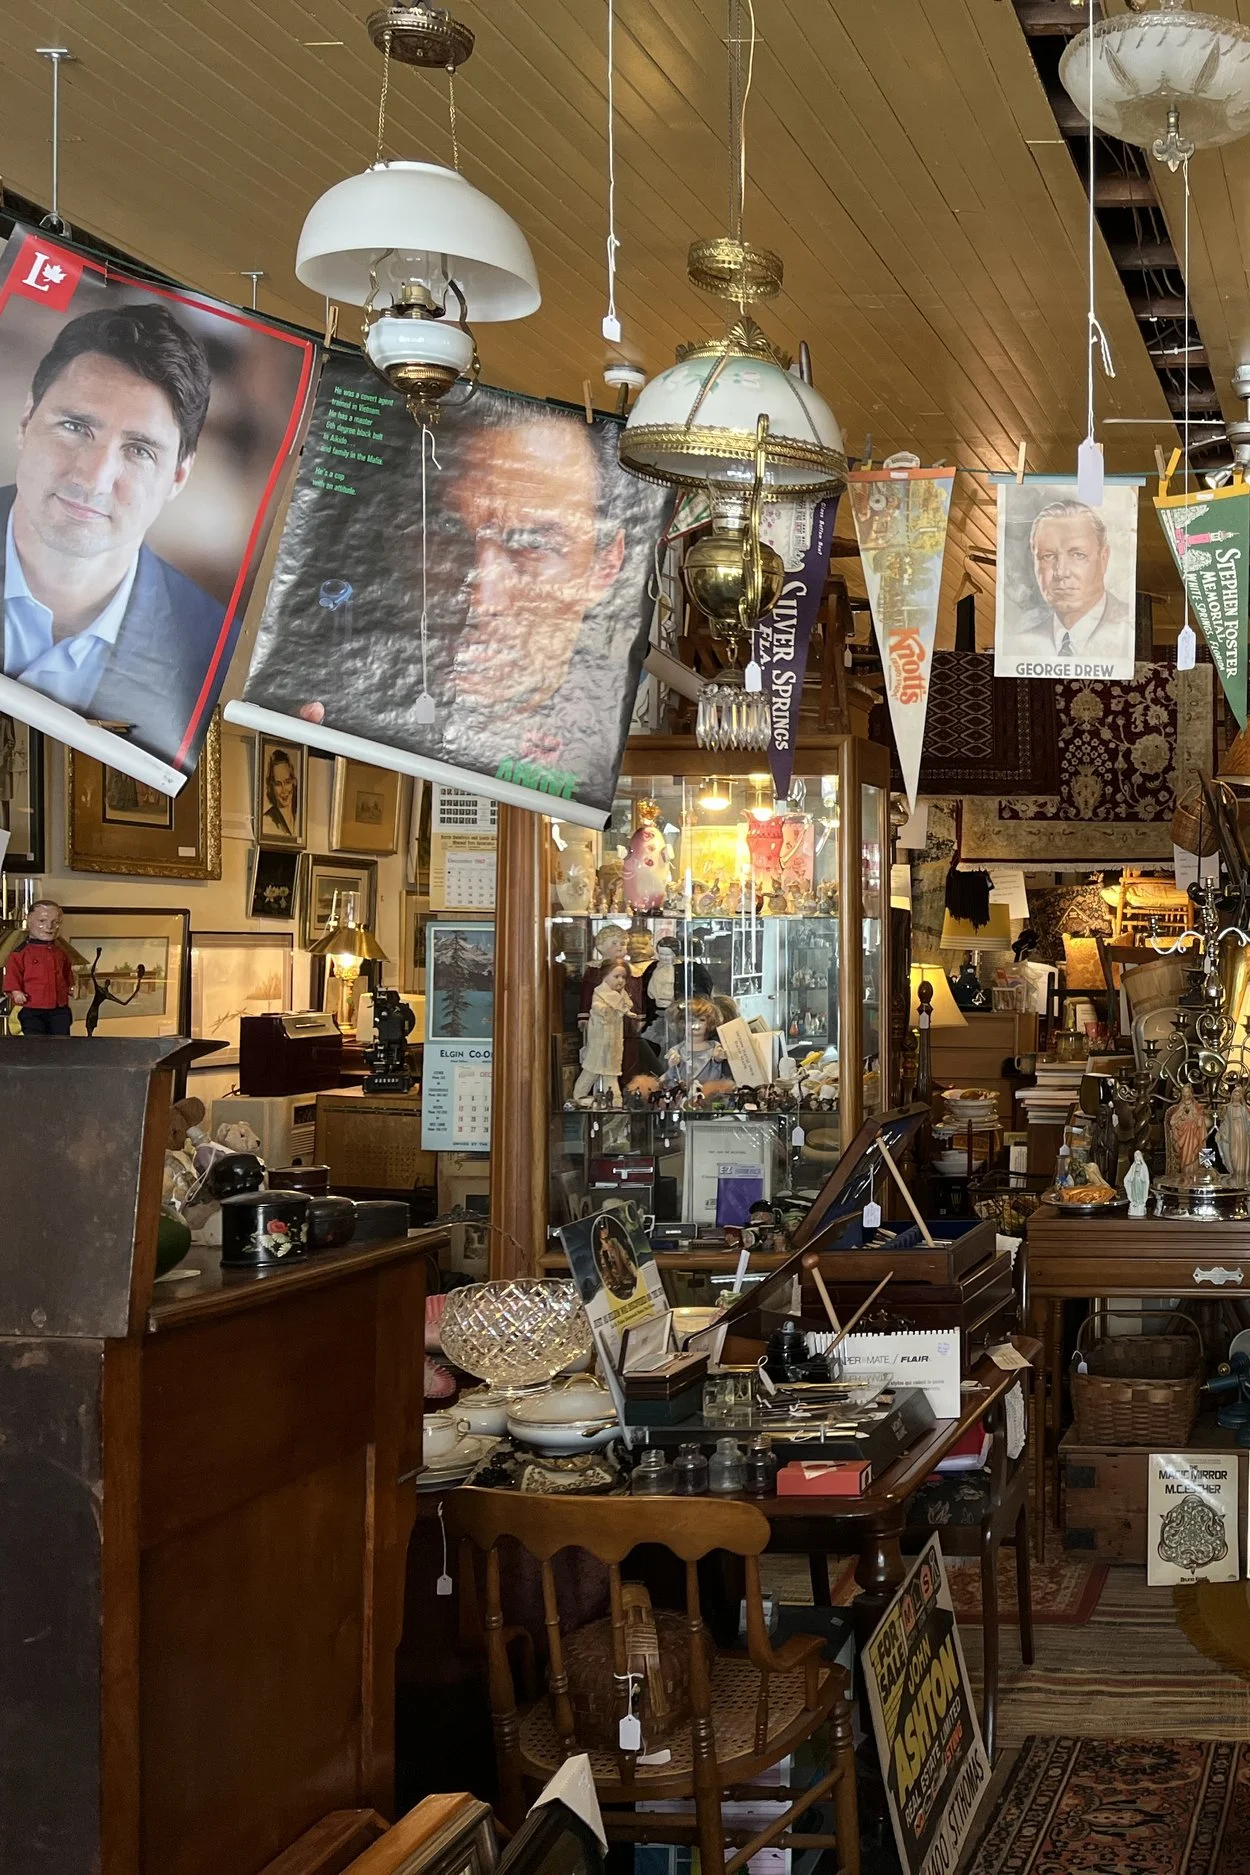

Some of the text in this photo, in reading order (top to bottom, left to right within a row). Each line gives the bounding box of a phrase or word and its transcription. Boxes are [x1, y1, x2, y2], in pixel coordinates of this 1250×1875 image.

[21, 251, 50, 292] L
[331, 398, 352, 410] trained
[334, 386, 343, 395] He
[343, 388, 355, 398] was
[360, 393, 378, 403] covert
[378, 397, 394, 407] agent
[328, 408, 337, 418] He
[337, 410, 349, 420] has
[353, 416, 373, 426] master
[336, 423, 356, 435] degree
[356, 427, 372, 438] black
[372, 431, 384, 441] belt
[320, 444, 332, 454] and
[331, 446, 350, 459] family
[350, 451, 357, 459] in
[356, 452, 366, 462] the
[314, 466, 328, 477] He's
[334, 472, 345, 482] cop
[325, 482, 334, 490] an
[1186, 572, 1203, 602] WHITE
[1200, 571, 1227, 644] MEMORIAL
[1215, 547, 1241, 679] STEPHEN FOSTER
[1016, 662, 1114, 677] GEORGE DREW
[866, 1356, 890, 1364] MATE
[900, 1355, 929, 1363] FLAIR
[1191, 1469, 1228, 1480] MIRROR
[877, 1622, 898, 1668] FOR
[879, 1643, 908, 1703] SALE
[907, 1632, 932, 1695] JOHN
[893, 1632, 960, 1811] ASHTON
[904, 1790, 922, 1829] REAL
[920, 1739, 942, 1793] ESTATE
[940, 1695, 962, 1747] LIMITED
